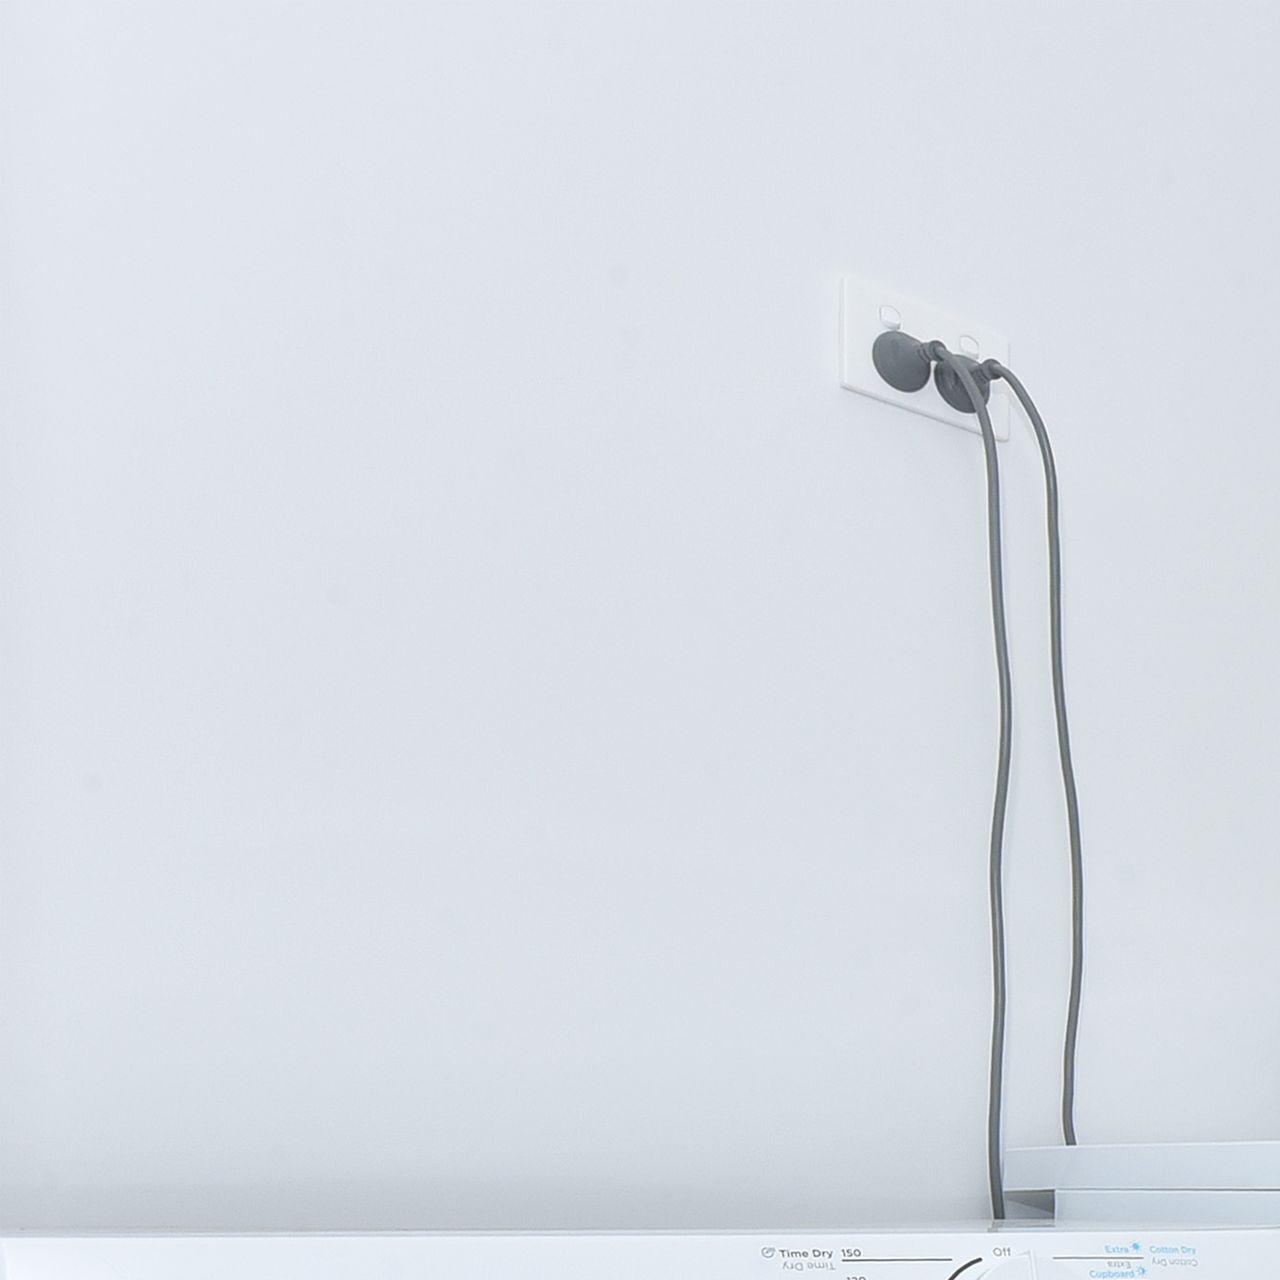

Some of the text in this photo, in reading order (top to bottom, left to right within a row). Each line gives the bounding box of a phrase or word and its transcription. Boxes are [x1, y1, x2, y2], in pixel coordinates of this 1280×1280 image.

[841, 1249, 862, 1257] 150
[993, 1248, 1011, 1257] Off
[1104, 1245, 1130, 1253] Extra
[1149, 1246, 1196, 1255] Cotton Dry
[779, 1249, 834, 1259] Time Dry
[782, 1261, 804, 1271] Dry
[1152, 1257, 1168, 1267] Dry
[1089, 1269, 1135, 1279] Cupboard
